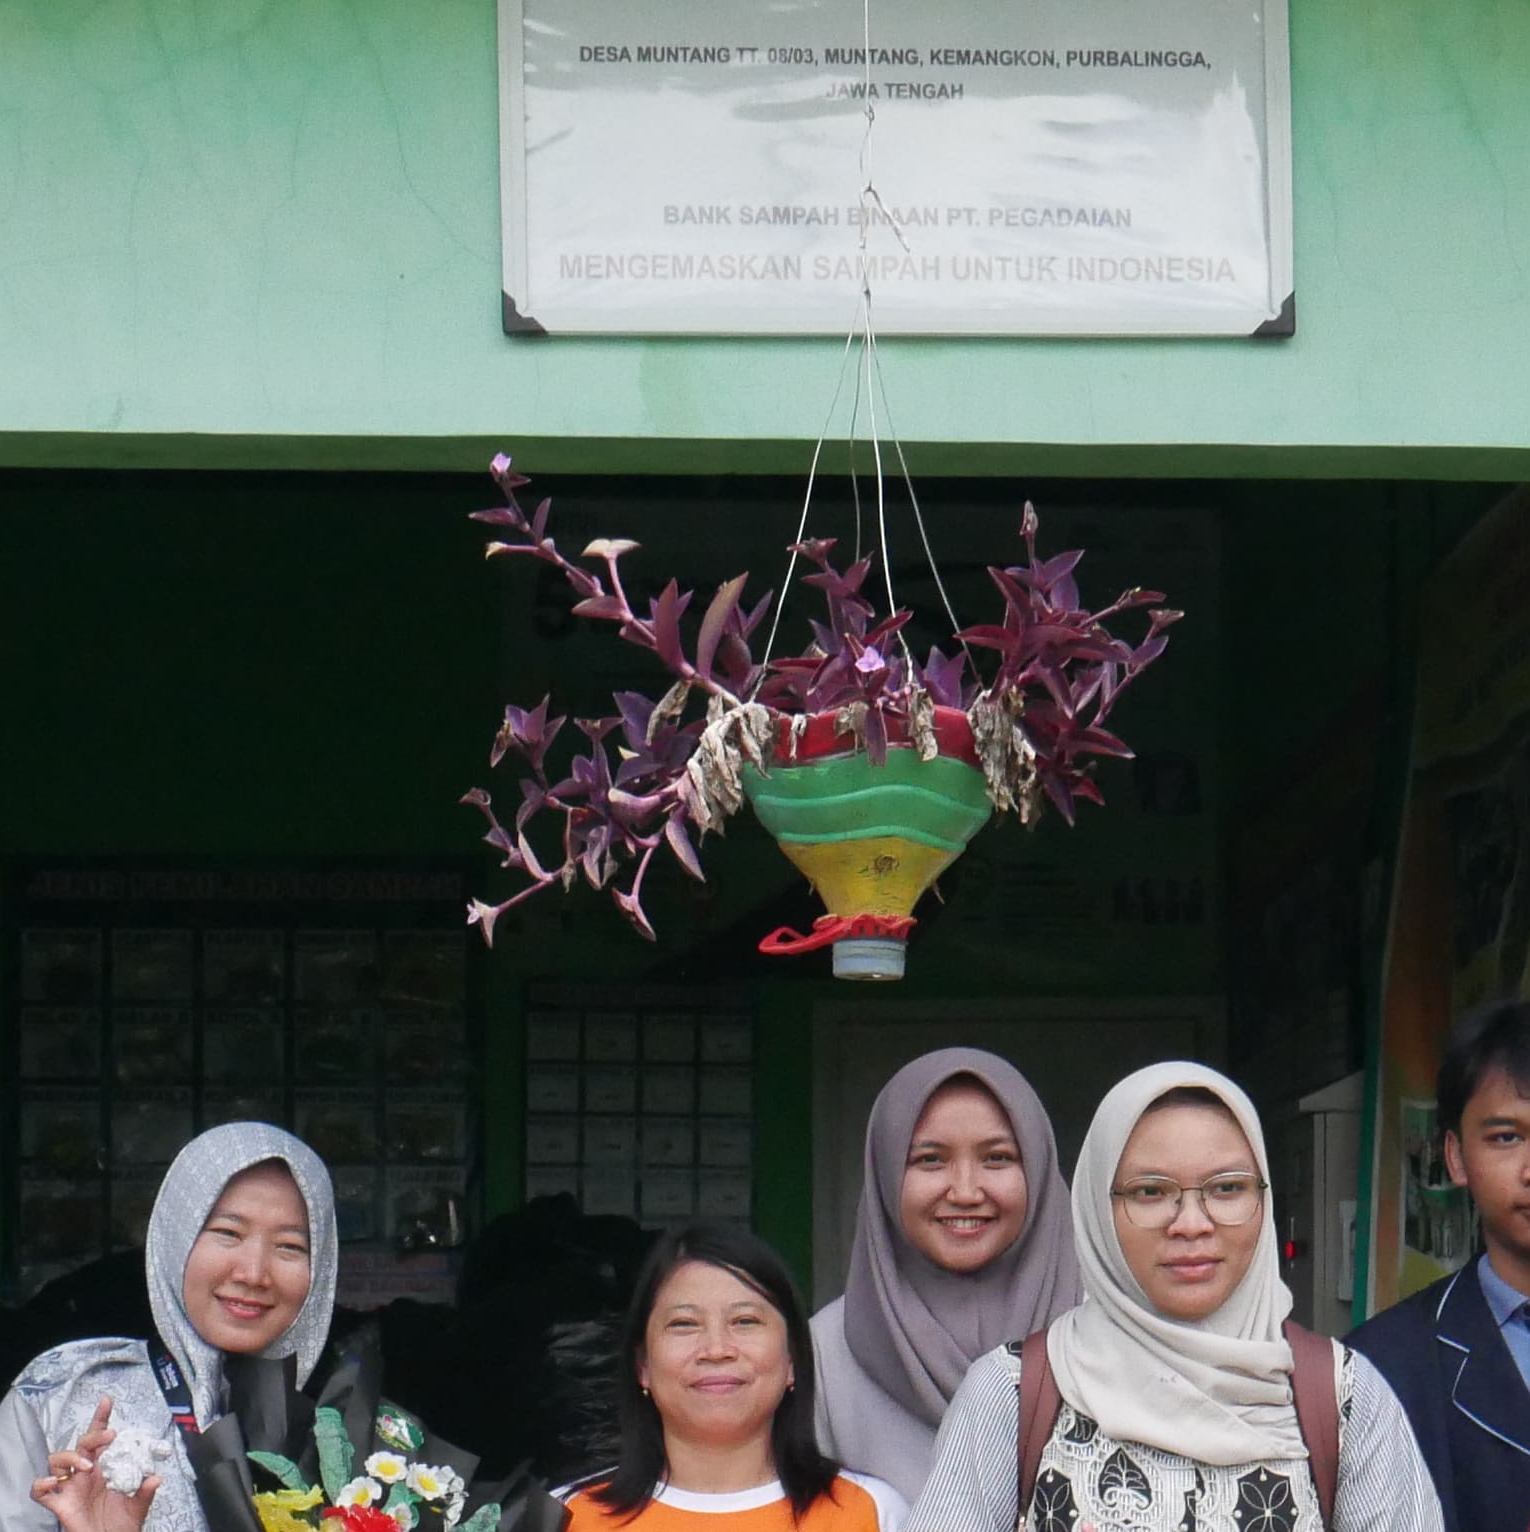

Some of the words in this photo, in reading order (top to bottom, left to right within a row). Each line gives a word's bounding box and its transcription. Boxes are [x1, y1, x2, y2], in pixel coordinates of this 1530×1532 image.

[580, 46, 632, 63] DESA
[637, 46, 731, 64] MUNTANG
[767, 47, 819, 67] 08/03,
[824, 48, 924, 68] MUNTANG,
[929, 49, 1061, 69] KEMANGKON,
[1065, 50, 1213, 71] PURBALINGGA,
[826, 82, 885, 100] JAWA
[887, 83, 965, 100] TENGAH
[663, 205, 732, 226] BANK
[739, 206, 840, 227] SAMPAH
[946, 207, 981, 228] PT.
[988, 207, 1133, 229] PEGADAIAN
[559, 254, 803, 282] MENGEMASKAN
[812, 255, 941, 283] SAMPAH
[952, 256, 1056, 283] UNTUK
[1067, 256, 1236, 284] INDONESIA
